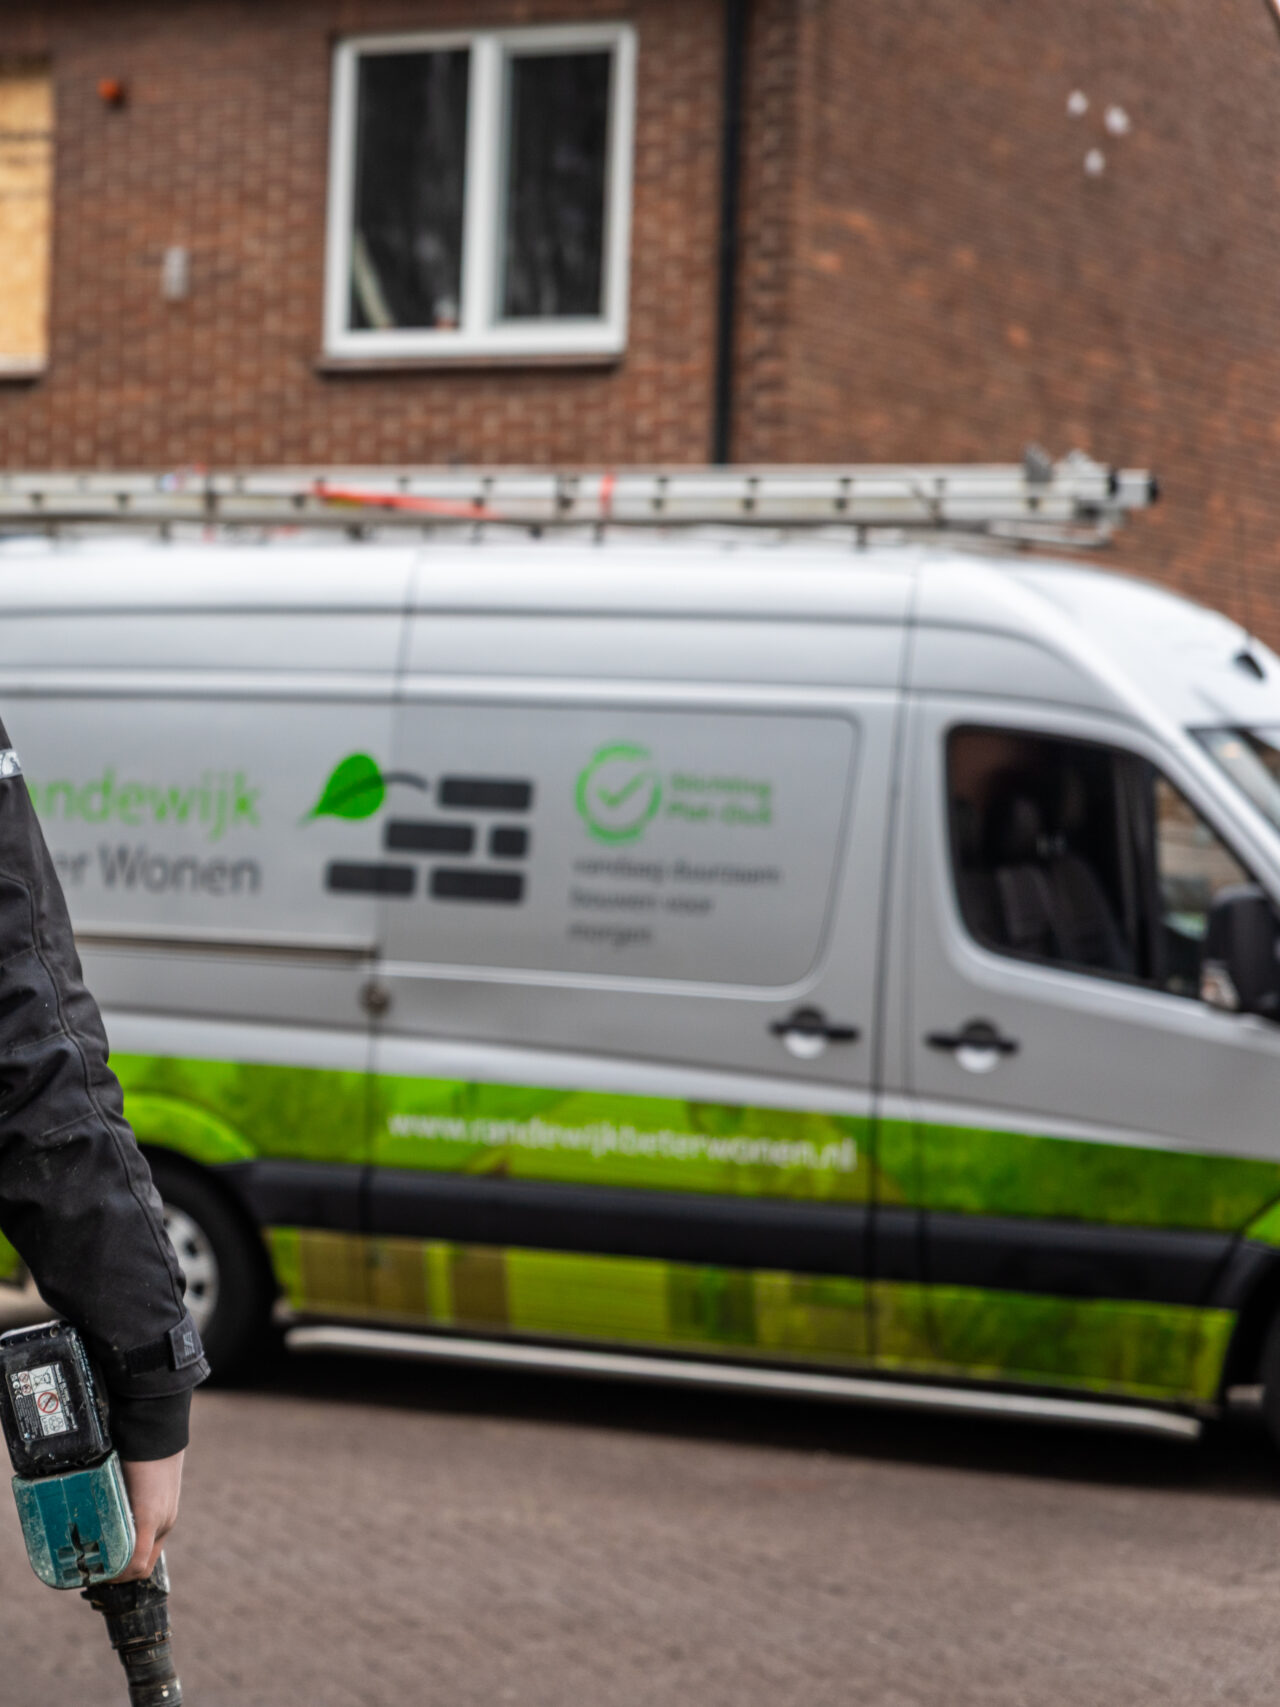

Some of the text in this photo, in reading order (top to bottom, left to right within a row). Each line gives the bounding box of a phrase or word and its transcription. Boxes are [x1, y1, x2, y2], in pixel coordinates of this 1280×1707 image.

[26, 766, 263, 844] ndewijk
[96, 842, 265, 896] Wonen
[385, 1112, 859, 1173] www.randewijkbeterwonen.nl
